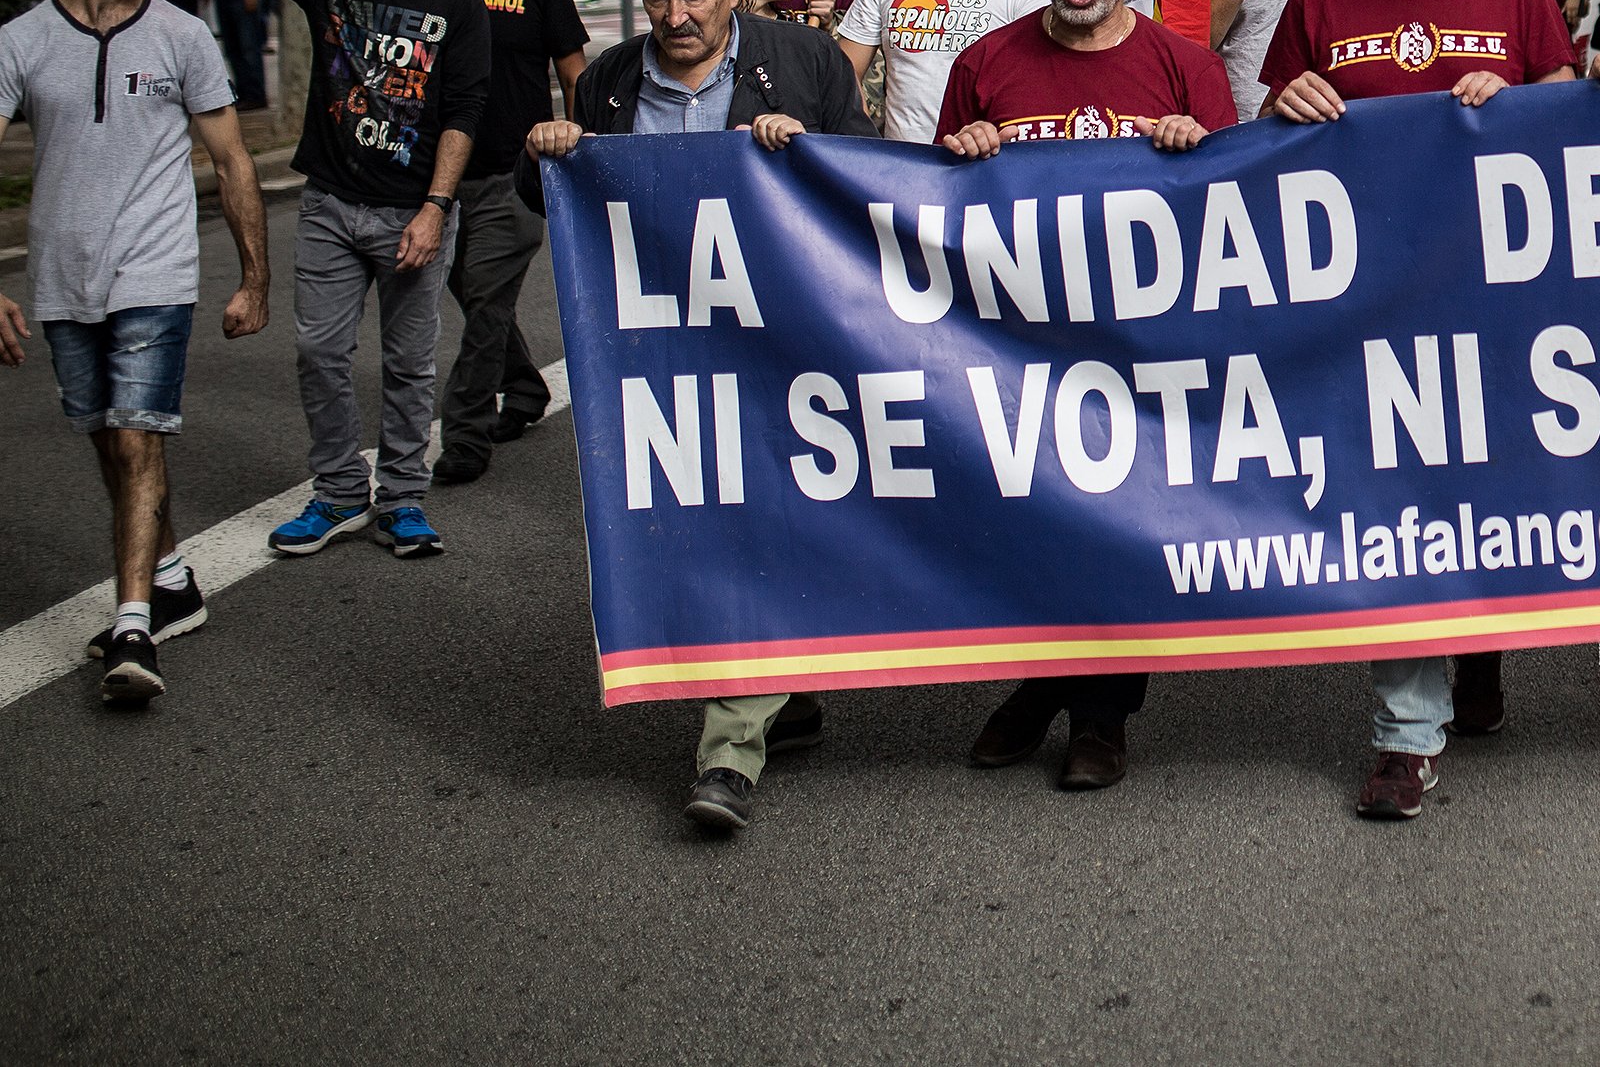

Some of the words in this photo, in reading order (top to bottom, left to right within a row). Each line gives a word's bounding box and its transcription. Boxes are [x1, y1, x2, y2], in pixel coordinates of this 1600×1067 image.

[887, 4, 991, 33] ESPAÑOLES
[1331, 39, 1391, 68] J.F.E.
[1442, 35, 1506, 55] S.E.U.
[146, 85, 170, 97] 1968
[607, 198, 764, 329] LA
[868, 169, 1358, 325] UNIDAD
[622, 373, 744, 509] NI
[789, 370, 935, 501] SE
[967, 353, 1325, 511] VOTA,
[1364, 333, 1489, 469] NI
